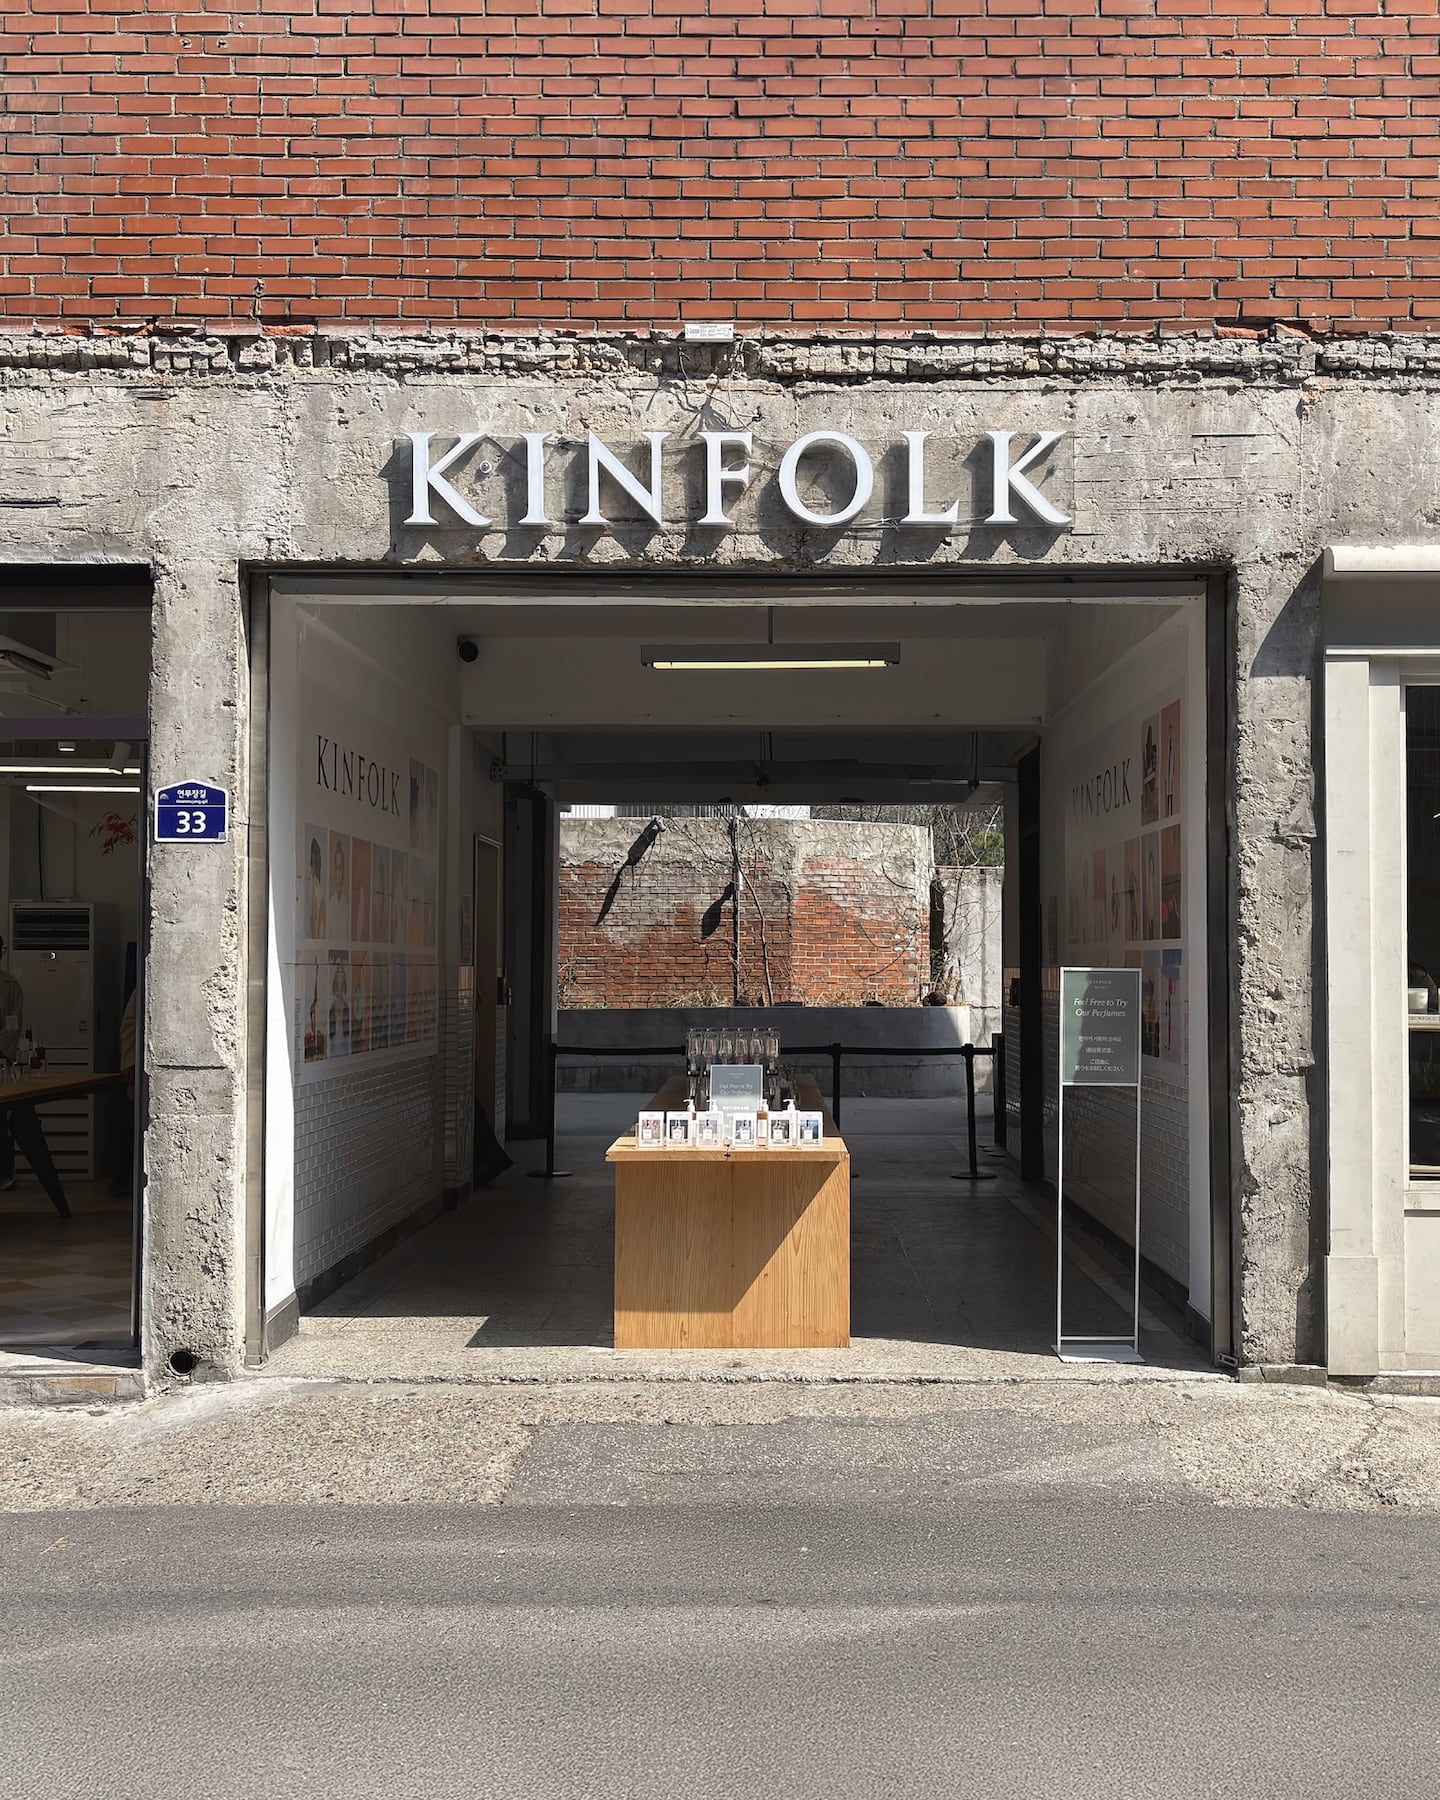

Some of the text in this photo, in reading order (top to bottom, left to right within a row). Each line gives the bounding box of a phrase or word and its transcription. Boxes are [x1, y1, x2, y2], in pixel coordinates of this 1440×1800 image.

[403, 430, 1074, 528] KINFOLK
[317, 734, 400, 817] KINFOLK
[177, 789, 206, 799] 연무장길
[176, 810, 206, 834] 33
[1074, 998, 1089, 1006] Feel
[1090, 998, 1105, 1006] Free
[1116, 999, 1128, 1008] Try
[1075, 1008, 1126, 1018] Our Perfumes
